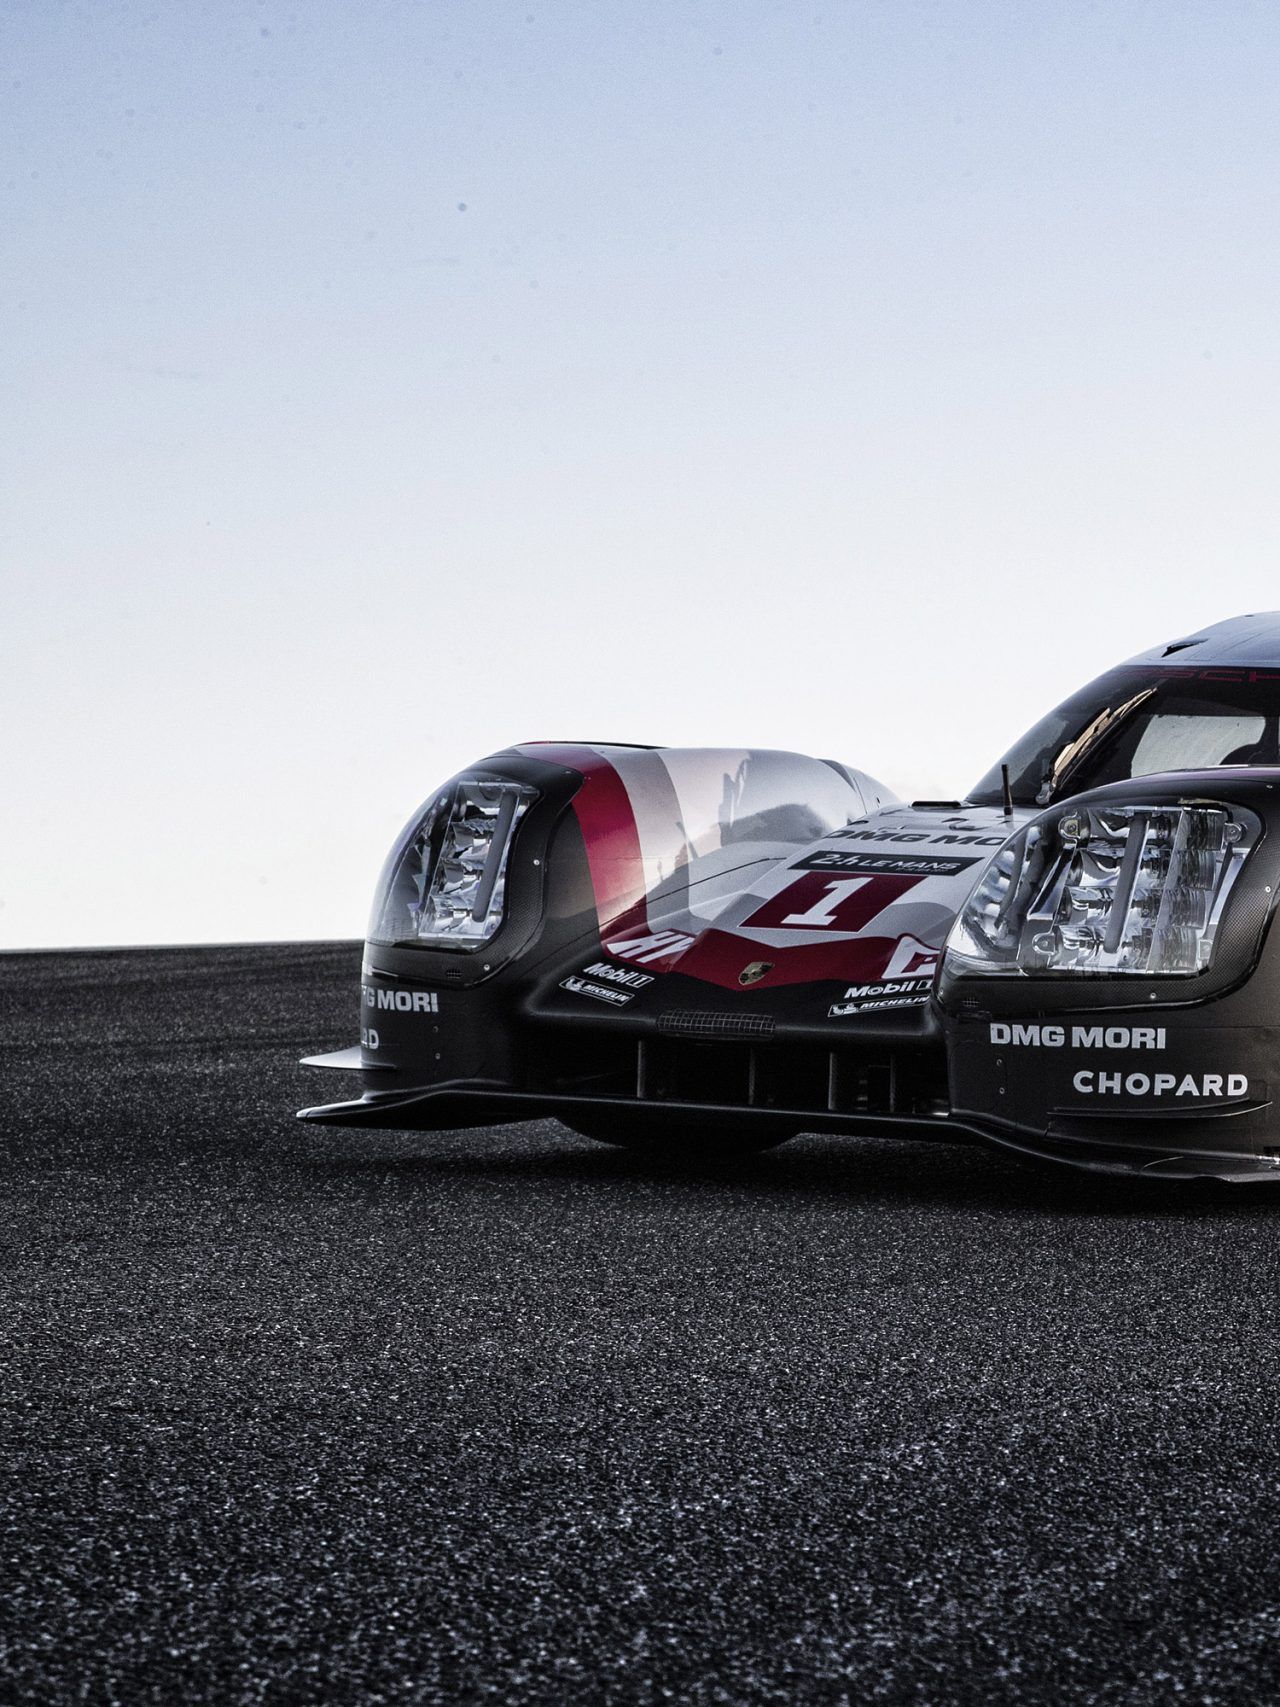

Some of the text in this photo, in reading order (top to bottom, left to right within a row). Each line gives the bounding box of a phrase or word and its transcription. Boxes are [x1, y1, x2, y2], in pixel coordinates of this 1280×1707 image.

[824, 830, 1007, 846] DMG MO
[861, 859, 893, 867] LE
[892, 861, 961, 870] MANS
[780, 876, 875, 926] 1
[582, 963, 640, 985] Mobil
[583, 984, 631, 1002] MICHELIN
[844, 981, 915, 999] Mobil
[377, 989, 439, 1012] MORI
[860, 996, 930, 1009] MICHELIN
[990, 1023, 1166, 1049] DMG MORI
[1073, 1071, 1249, 1096] CHOPARD
